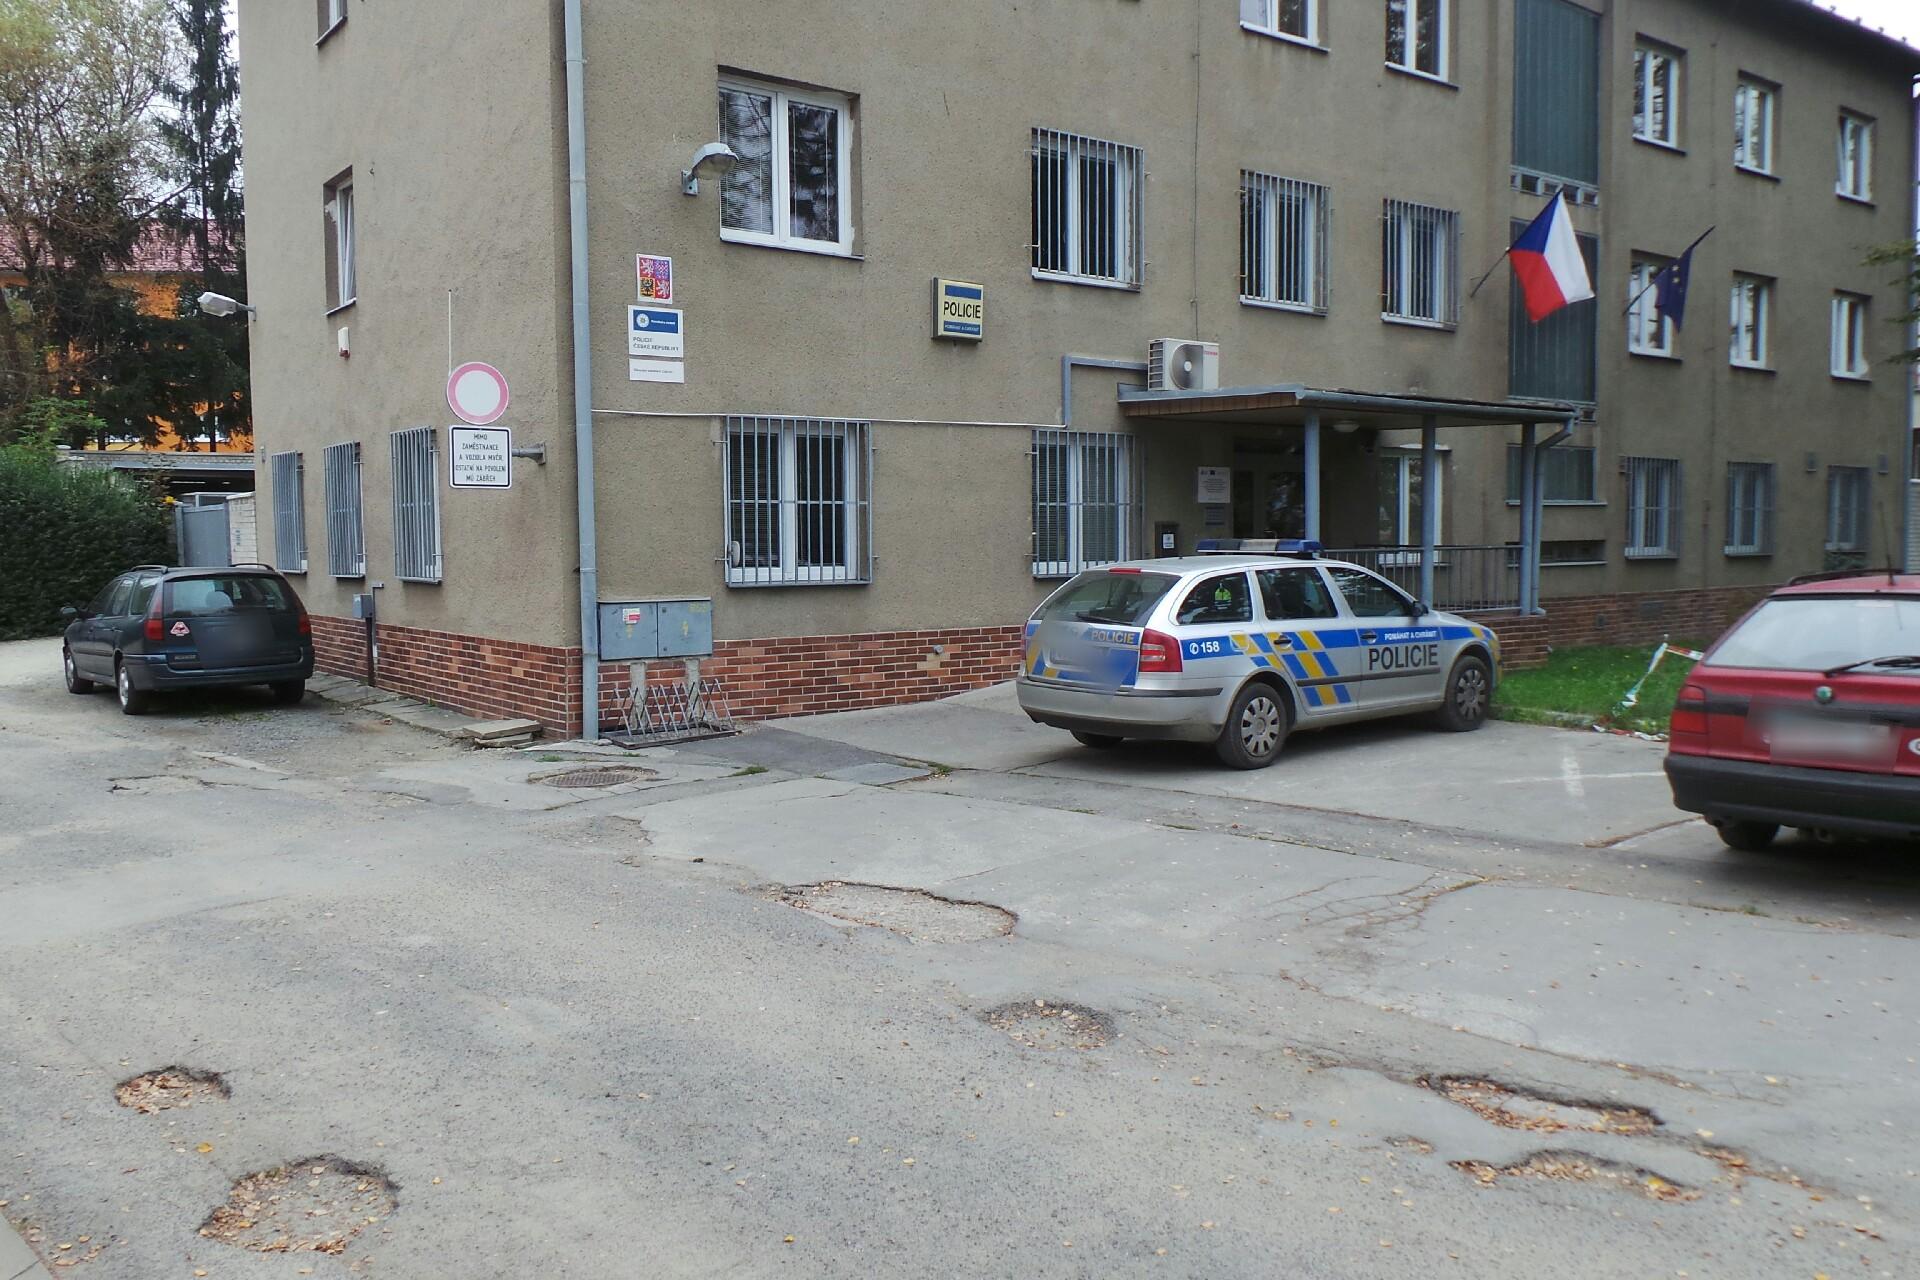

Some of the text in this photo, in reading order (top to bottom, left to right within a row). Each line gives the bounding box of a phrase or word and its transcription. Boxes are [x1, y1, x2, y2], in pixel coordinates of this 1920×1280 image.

[943, 301, 981, 319] POLICIE
[473, 433, 488, 441] MIMO
[1091, 630, 1136, 644] POLICIE
[1200, 641, 1220, 654] 158
[1368, 644, 1439, 671] POLICIE
